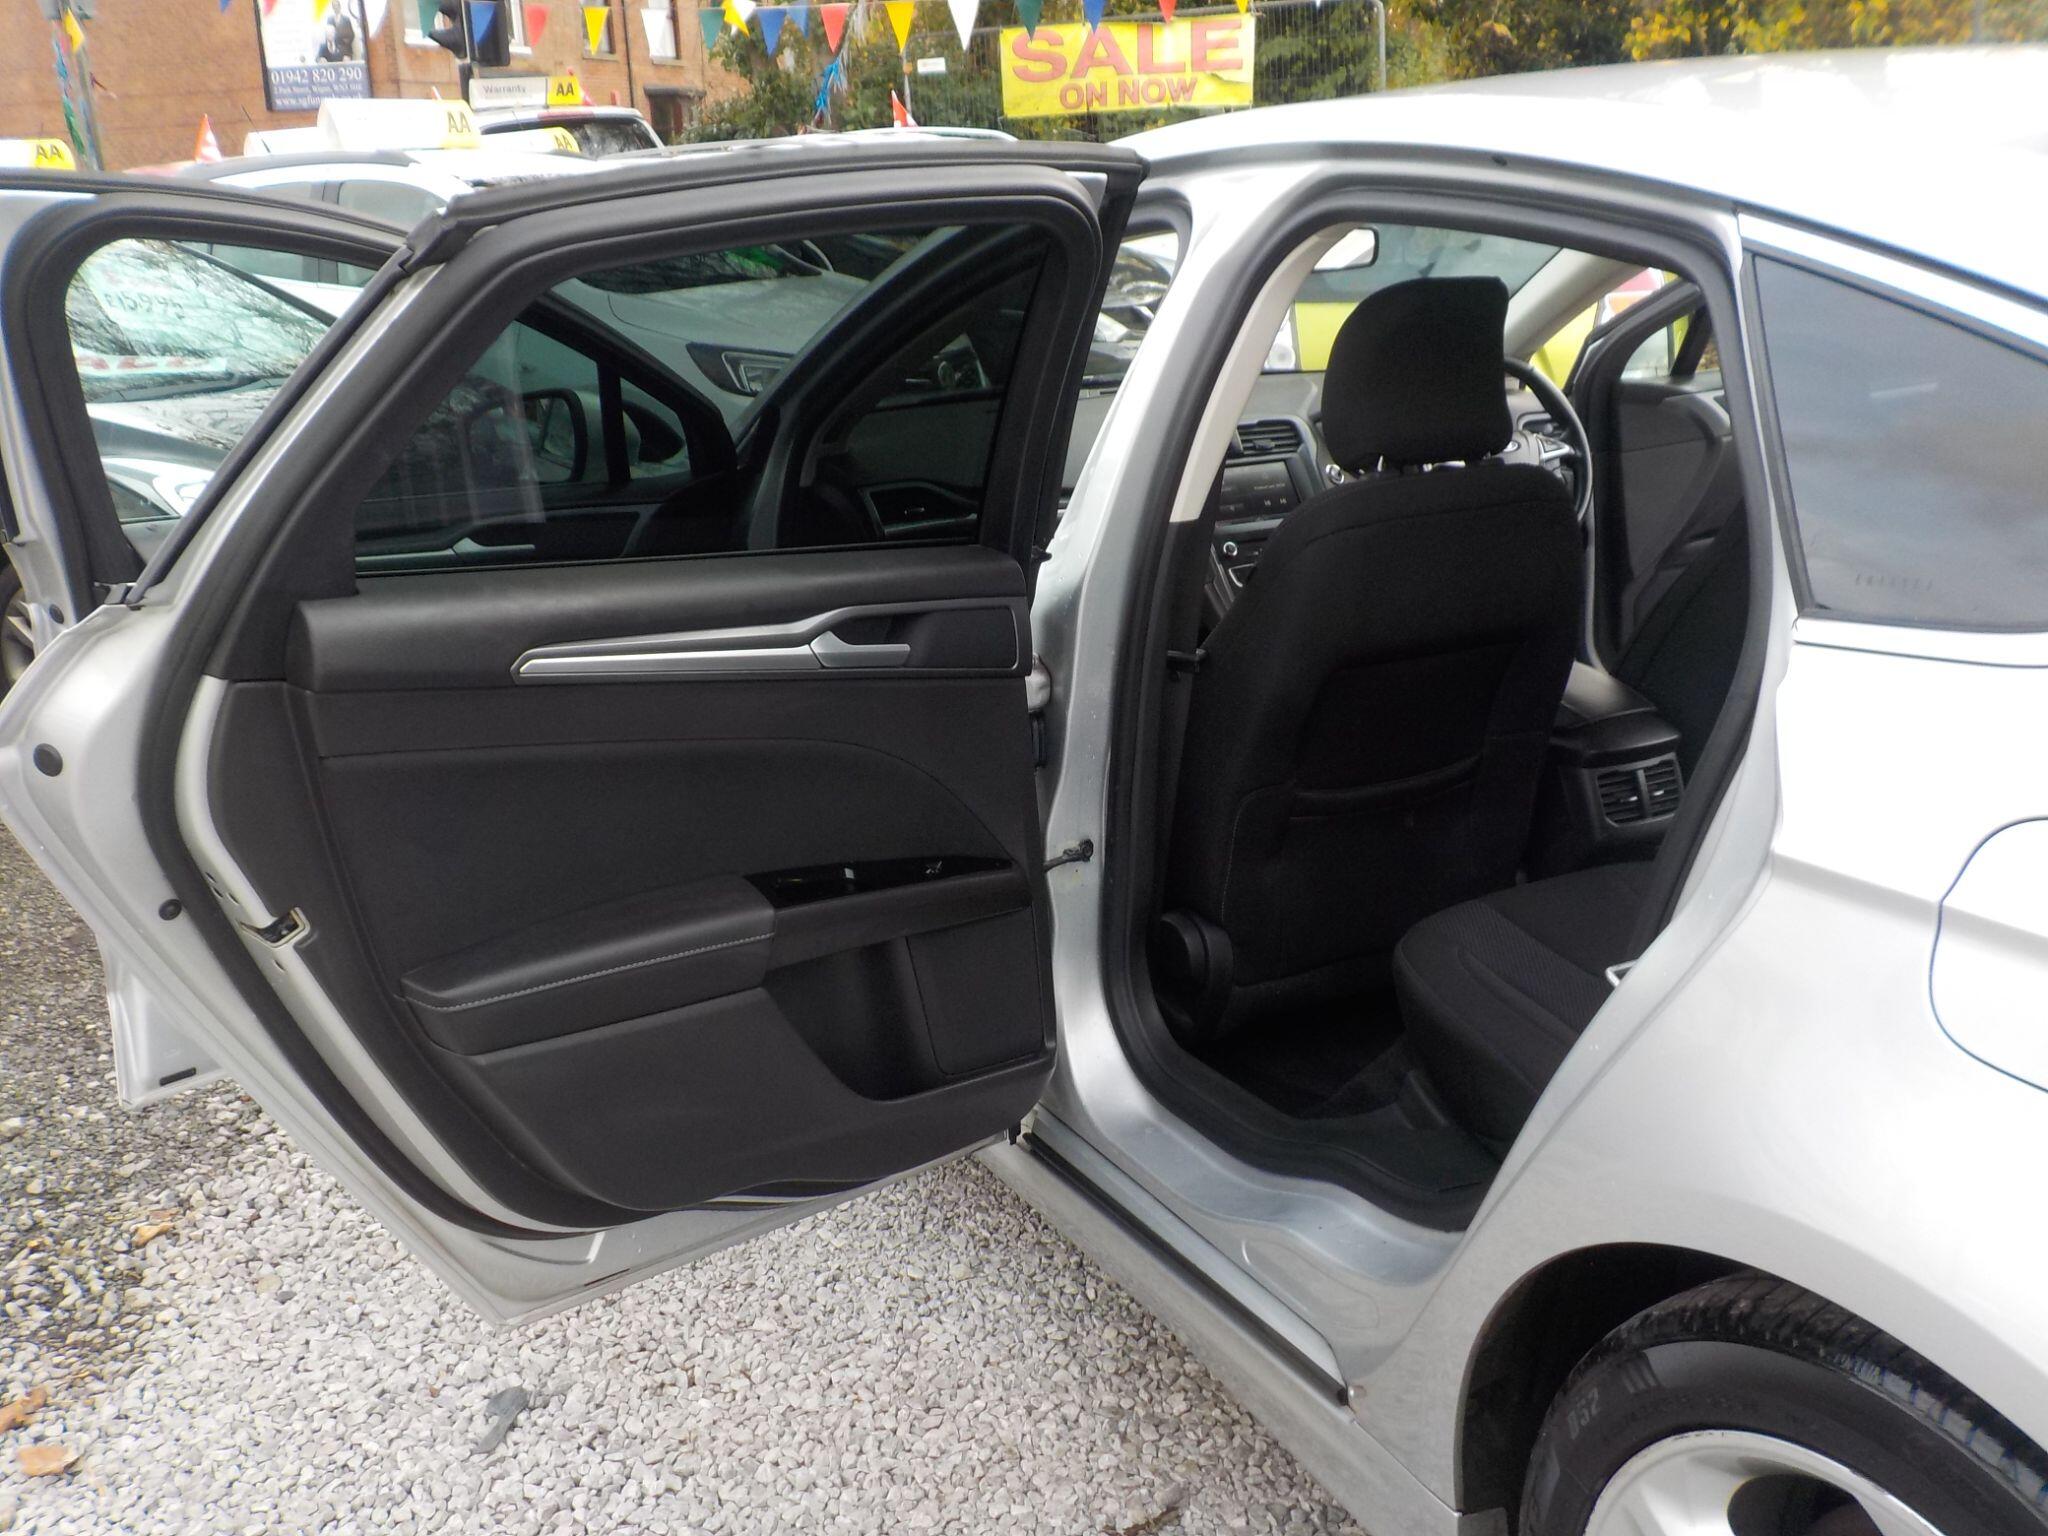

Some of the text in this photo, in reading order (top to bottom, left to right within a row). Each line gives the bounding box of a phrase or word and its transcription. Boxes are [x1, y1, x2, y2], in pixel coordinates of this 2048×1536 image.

[1012, 19, 1244, 83] SALE
[271, 67, 362, 84] 01942 820 290
[482, 84, 526, 95] Warranty
[556, 82, 575, 96] AA
[1059, 77, 1197, 109] ON NOW
[447, 111, 471, 133] AA
[554, 134, 572, 149] AA
[36, 143, 64, 160] AA
